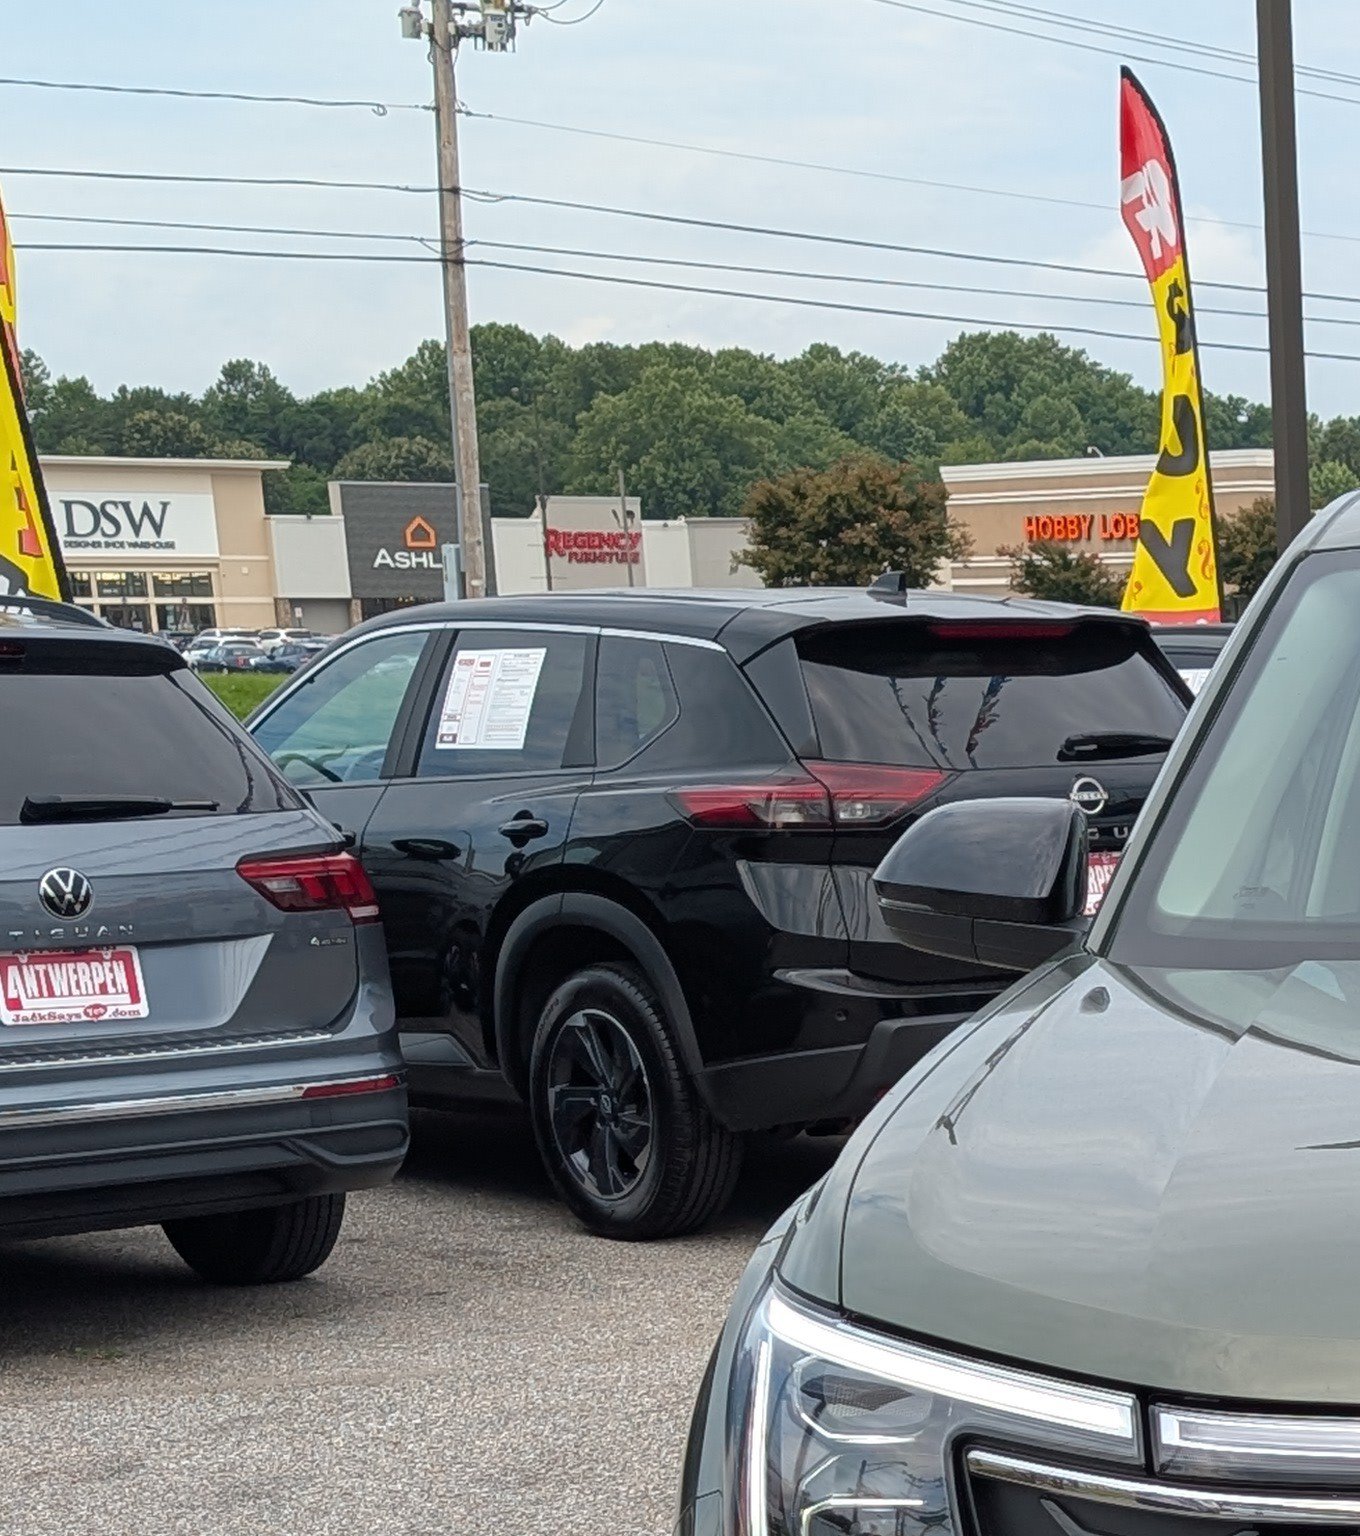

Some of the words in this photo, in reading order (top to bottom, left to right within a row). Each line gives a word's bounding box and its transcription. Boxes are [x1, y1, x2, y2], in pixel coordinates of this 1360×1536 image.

[60, 500, 171, 538] DSW
[1024, 514, 1094, 541] HOBBY
[1099, 512, 1140, 540] LOB
[63, 541, 102, 549] DESIGNER
[104, 541, 126, 549] SHOE
[127, 541, 176, 550] WAREHOUSE
[545, 527, 642, 557] REGENCY
[373, 548, 443, 569] ASHL
[8, 924, 134, 940] TIGUAN
[7, 960, 130, 1000] ANTWERPEN
